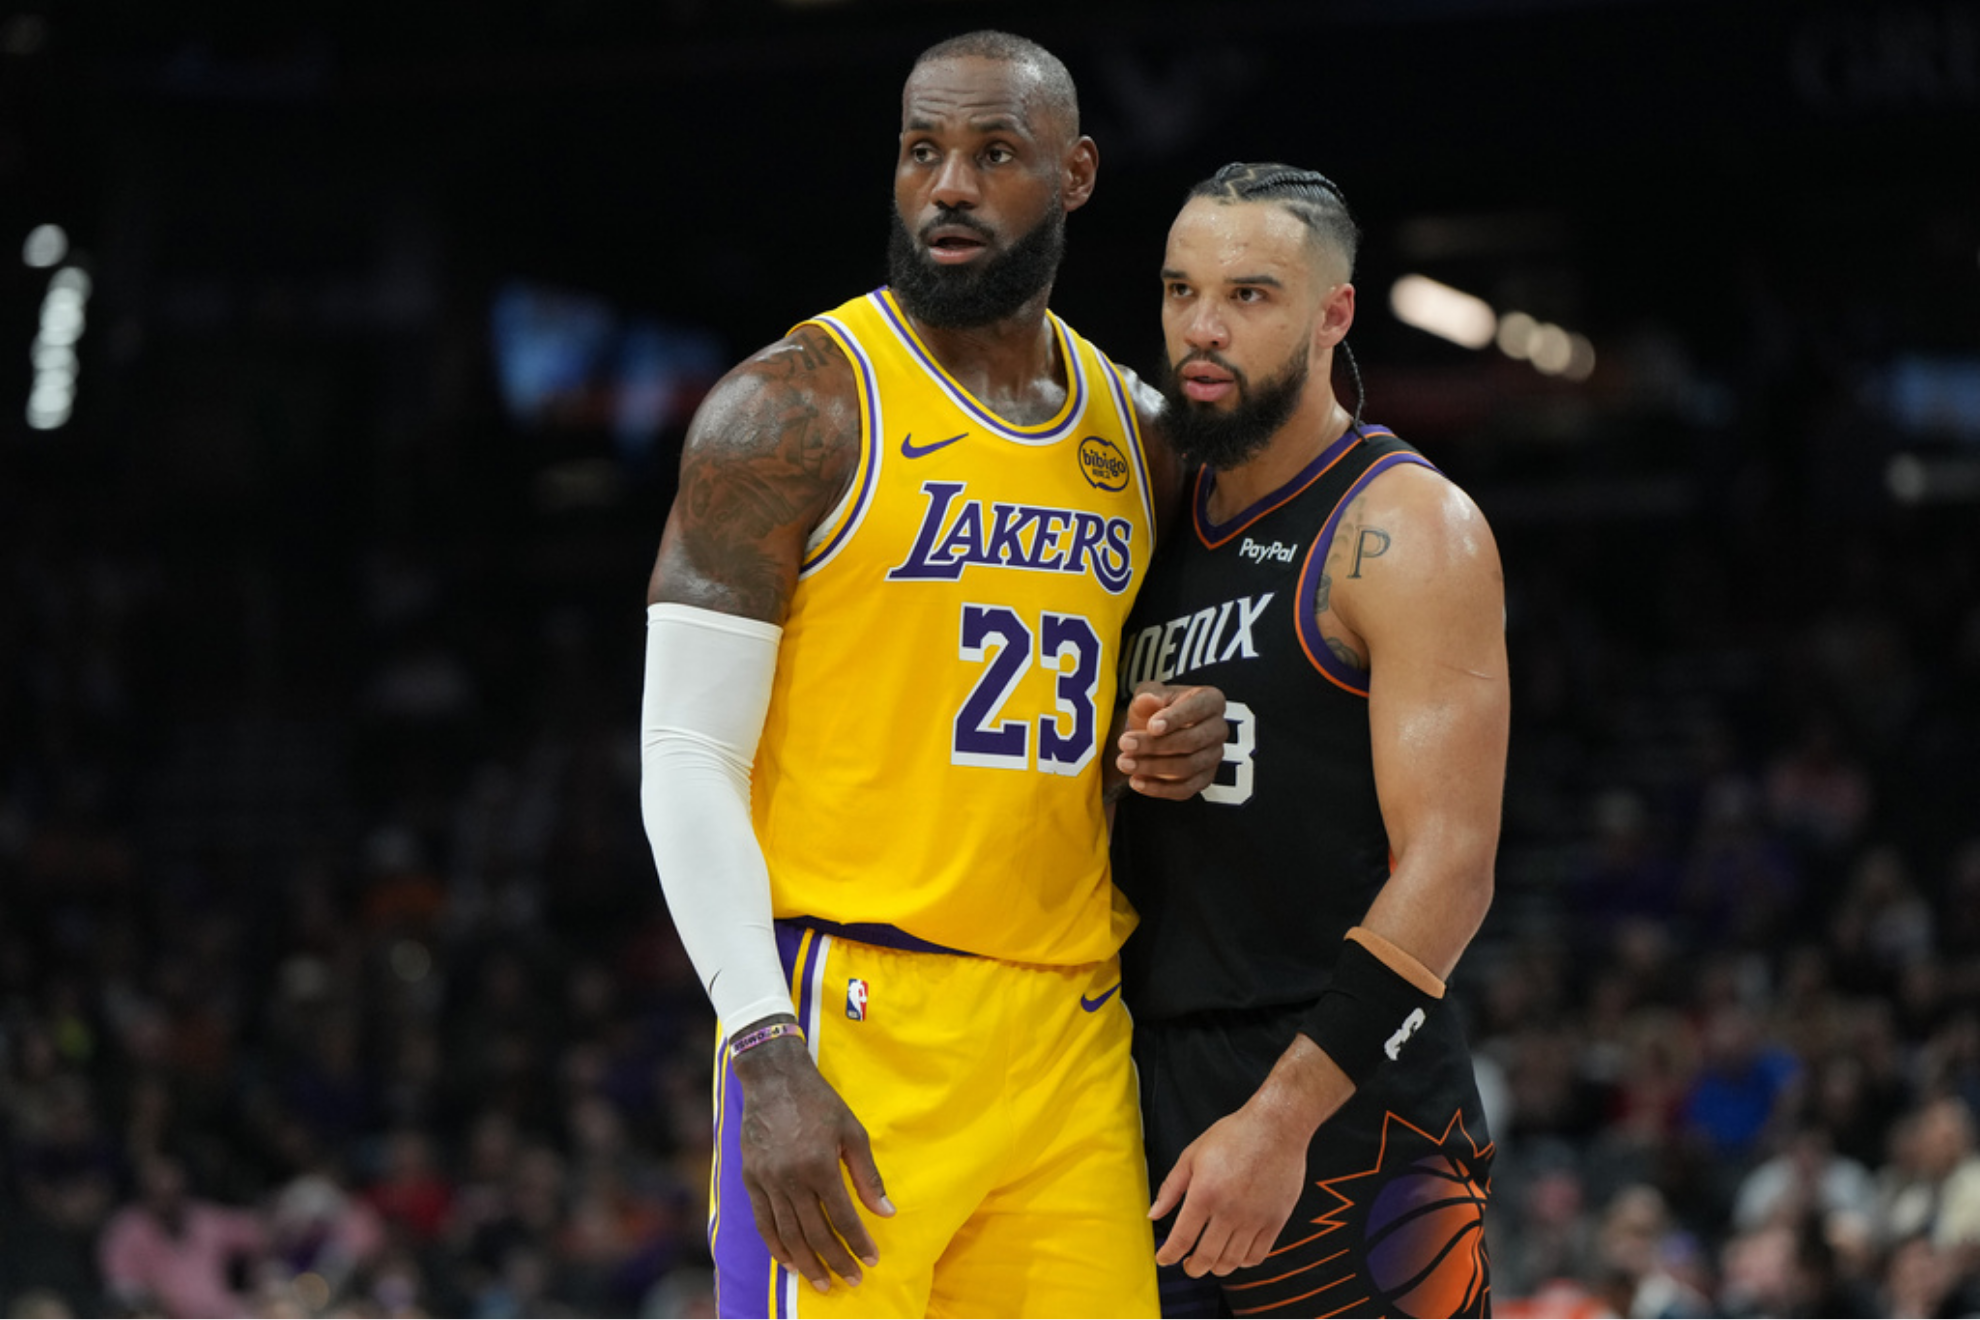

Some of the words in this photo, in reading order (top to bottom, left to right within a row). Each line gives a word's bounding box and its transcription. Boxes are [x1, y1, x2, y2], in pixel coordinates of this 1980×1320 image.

[1082, 449, 1126, 477] bibigo
[884, 480, 1133, 595] LAKERS
[1239, 537, 1298, 564] PayPal
[950, 602, 1103, 777] 23
